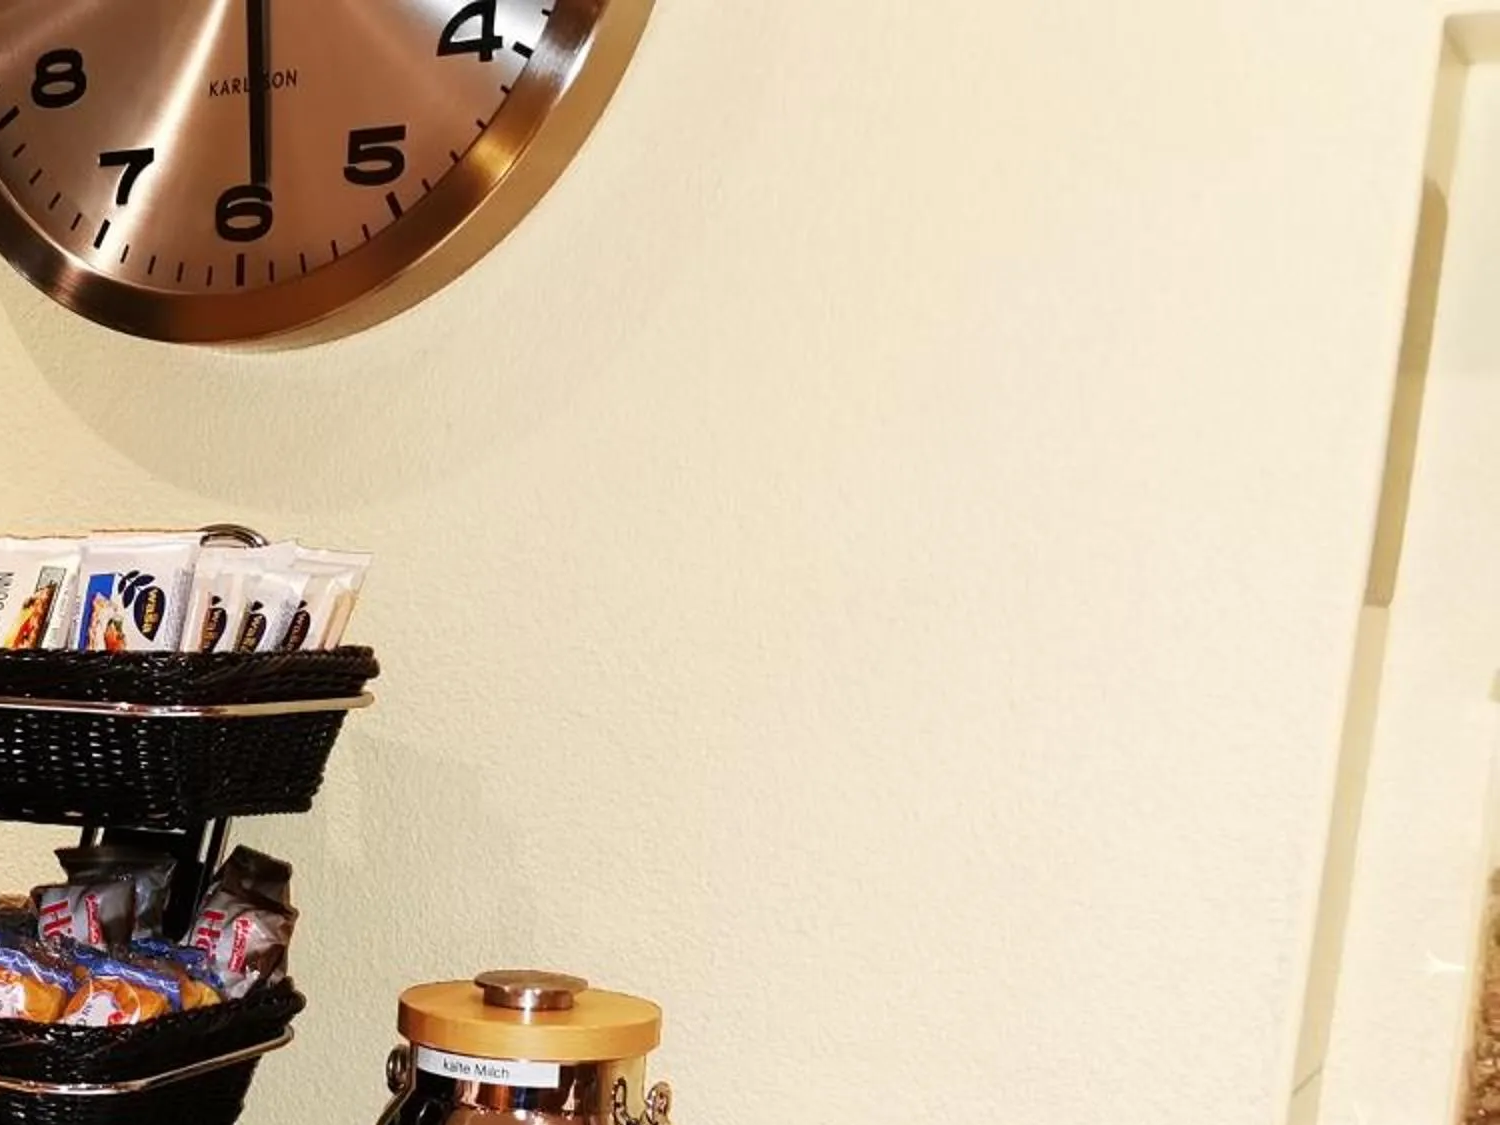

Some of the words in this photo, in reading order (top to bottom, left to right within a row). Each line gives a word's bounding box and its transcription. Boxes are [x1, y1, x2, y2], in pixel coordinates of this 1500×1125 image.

[436, 0, 503, 62] 4
[31, 49, 87, 108] 8
[100, 148, 155, 205] 7
[343, 125, 406, 186] 5
[214, 183, 273, 242] 6
[474, 1063, 510, 1080] Milch
